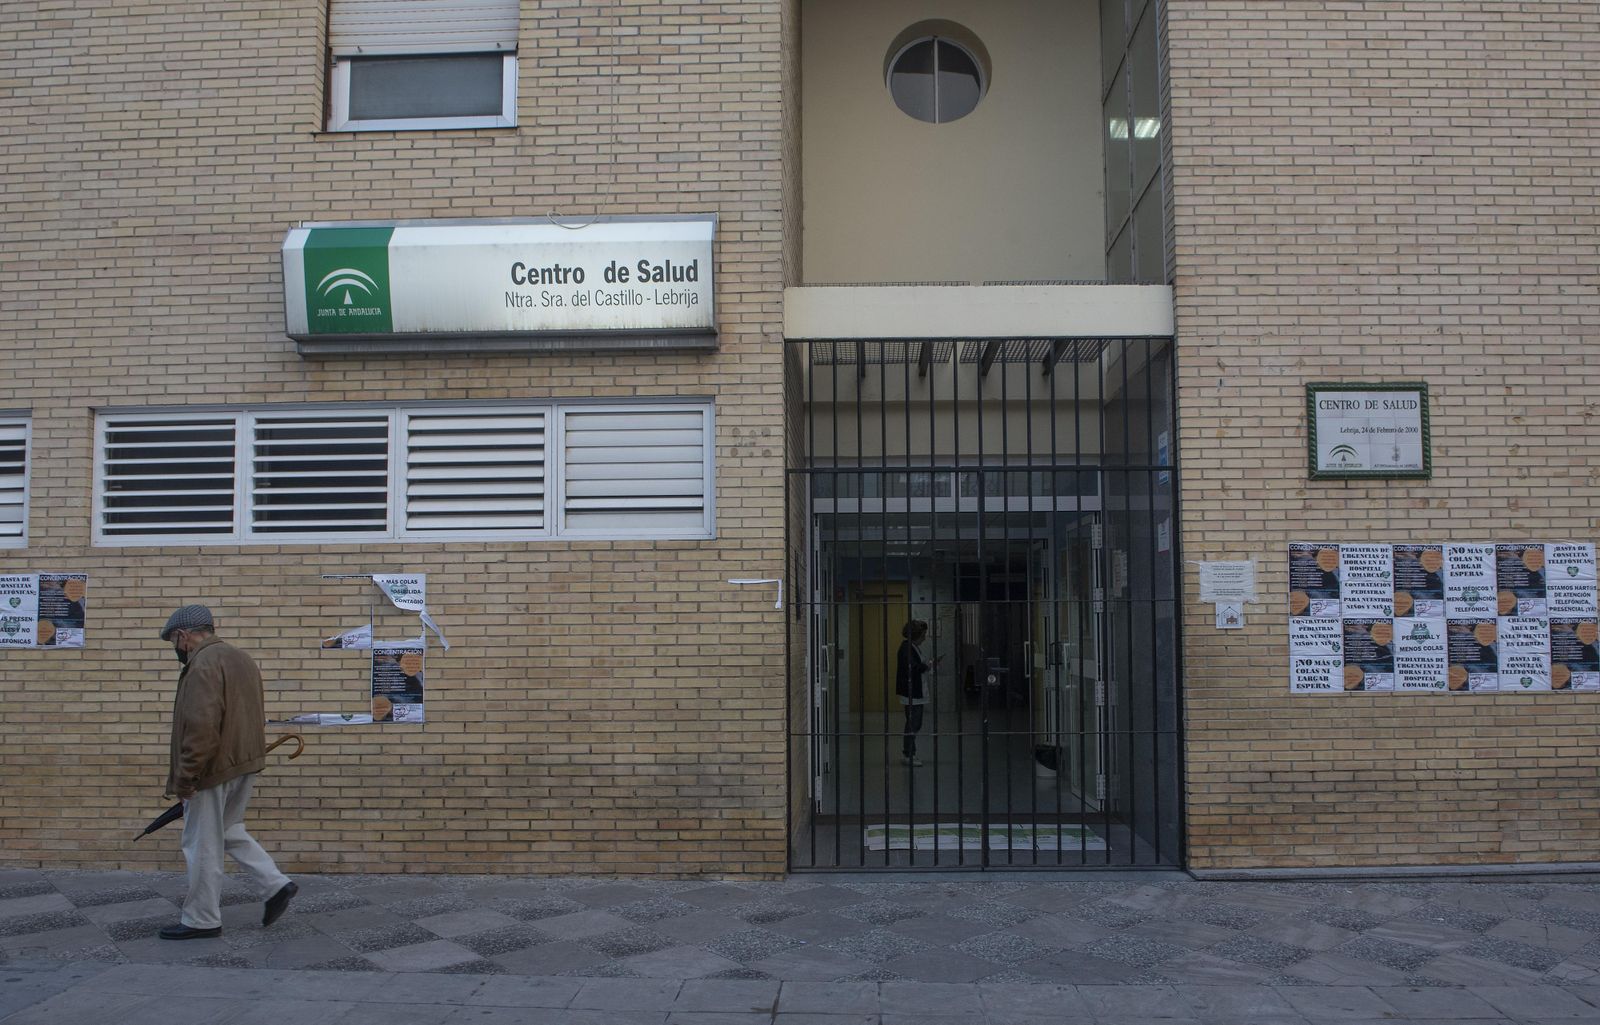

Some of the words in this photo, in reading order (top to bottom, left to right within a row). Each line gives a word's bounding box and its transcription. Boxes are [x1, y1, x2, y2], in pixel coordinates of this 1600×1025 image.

[511, 262, 585, 285] Centro
[604, 260, 629, 284] de
[637, 259, 699, 283] Salud
[505, 291, 537, 308] Ntra.
[541, 290, 567, 307] Sra.
[571, 289, 590, 306] del
[595, 289, 643, 306] Castillo
[654, 289, 699, 308] Lebrija
[317, 308, 336, 317] JUNTA
[338, 308, 347, 316] DE
[1319, 399, 1360, 410] CENTRO
[1365, 400, 1379, 410] DE
[1383, 399, 1417, 410] SALUD
